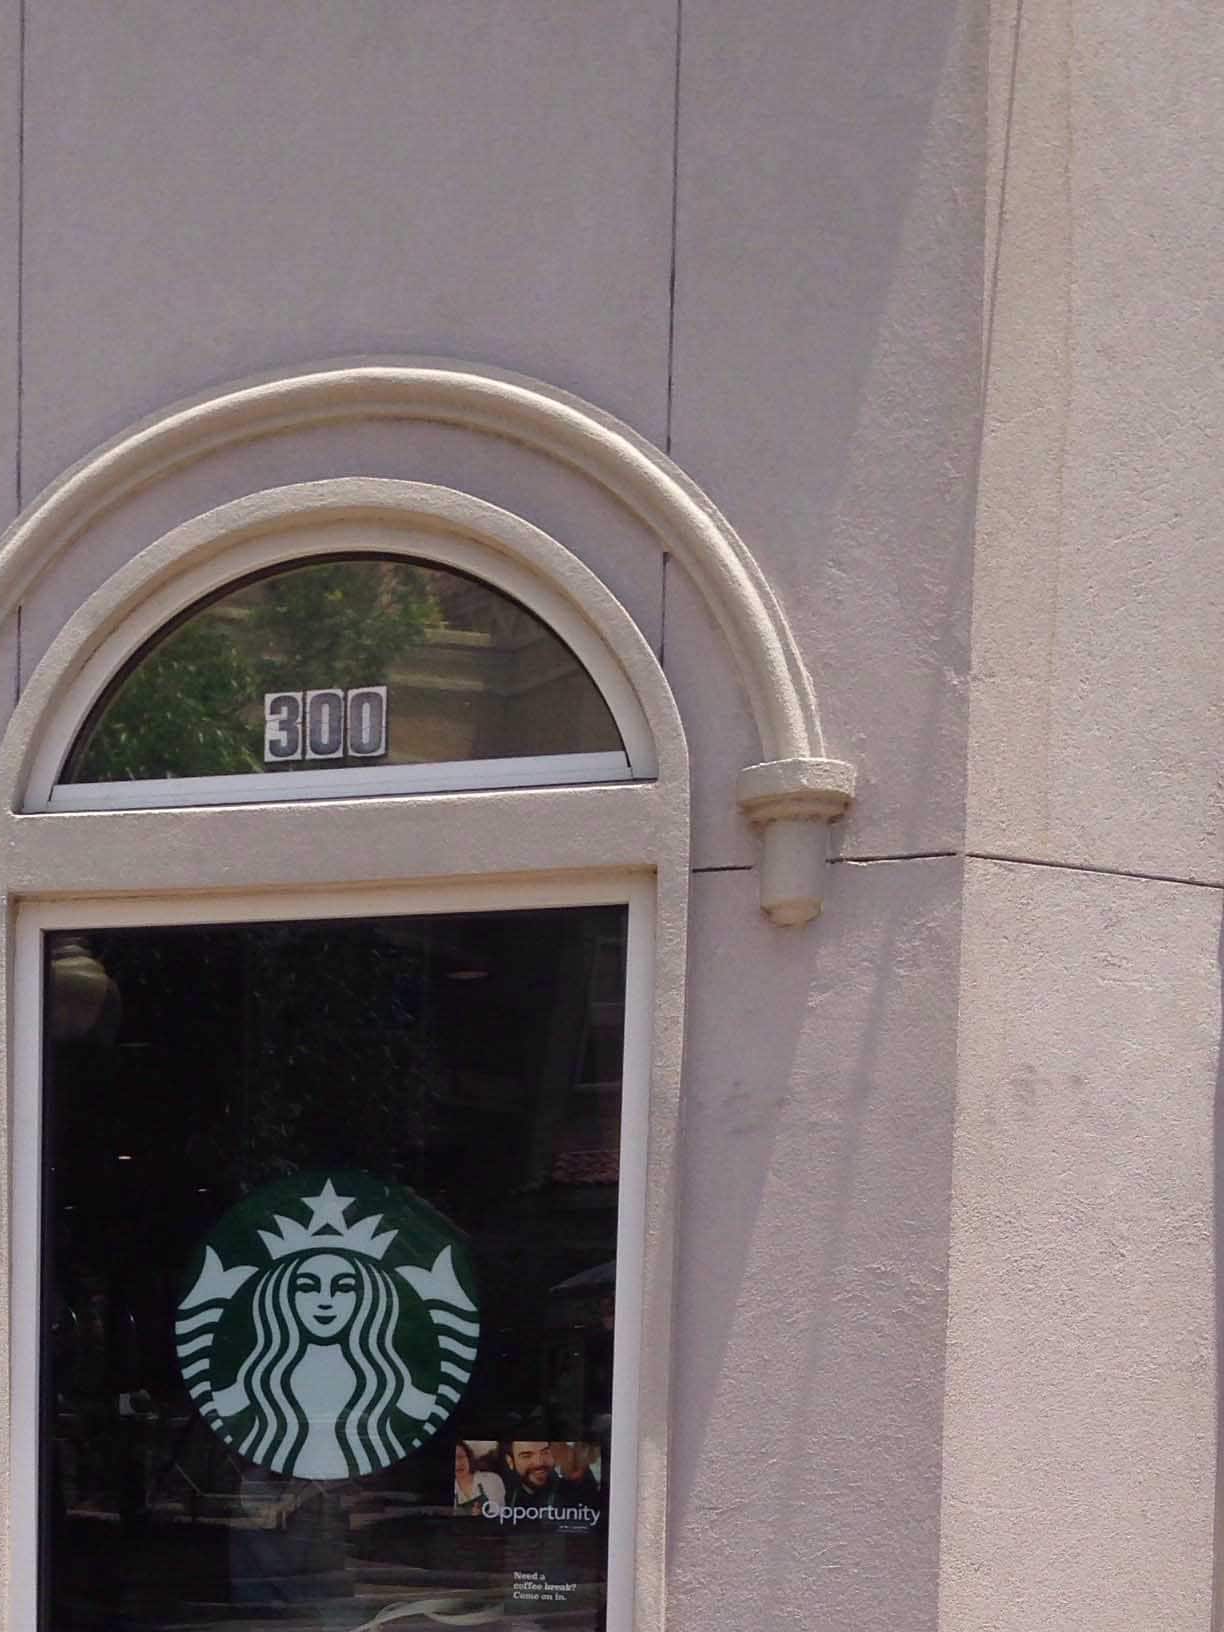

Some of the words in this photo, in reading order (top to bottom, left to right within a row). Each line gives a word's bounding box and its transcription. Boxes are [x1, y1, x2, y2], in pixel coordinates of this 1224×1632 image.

[268, 692, 384, 758] 300
[482, 1501, 601, 1525] Opportunity
[513, 1571, 538, 1581] Need
[539, 1573, 546, 1581] a
[513, 1581, 543, 1591] coffee
[544, 1582, 577, 1592] break?
[513, 1591, 539, 1600] Come
